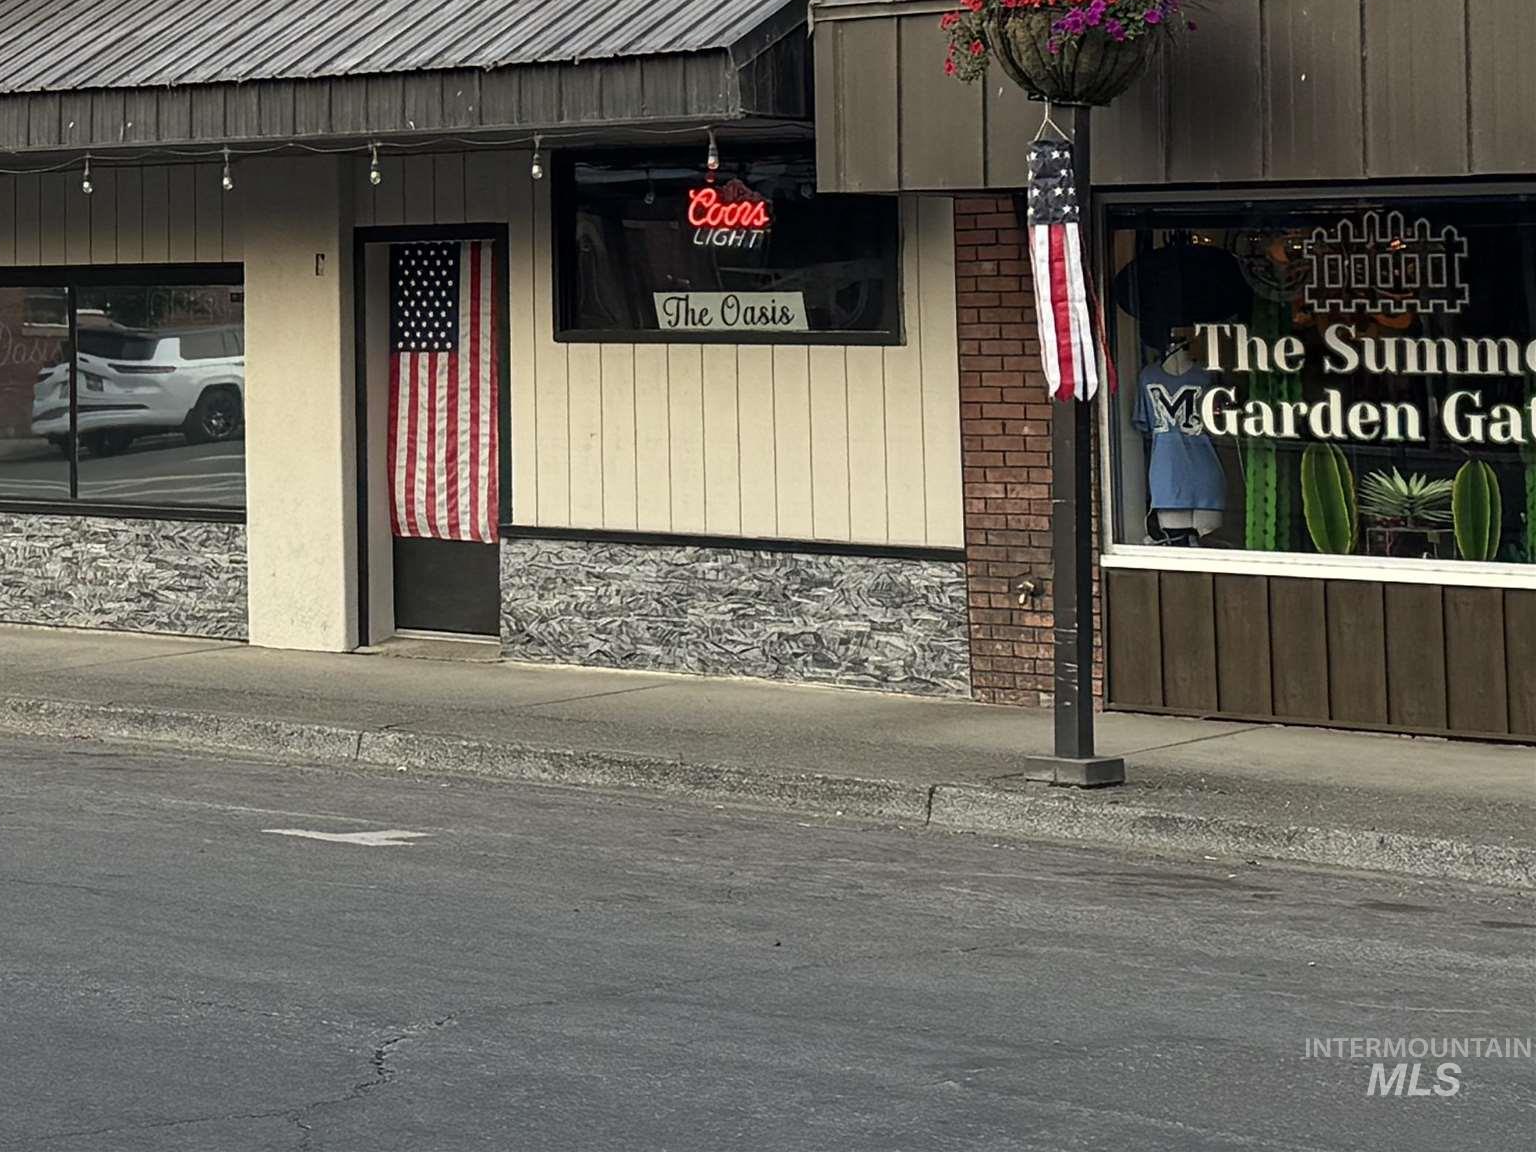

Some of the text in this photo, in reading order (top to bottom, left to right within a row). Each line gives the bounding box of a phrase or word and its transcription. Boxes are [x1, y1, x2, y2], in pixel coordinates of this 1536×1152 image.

[688, 188, 770, 226] Coors
[693, 228, 764, 248] LIGHT
[664, 294, 796, 328] The Oasis
[1195, 323, 1305, 373] The
[1201, 386, 1425, 443] Garden
